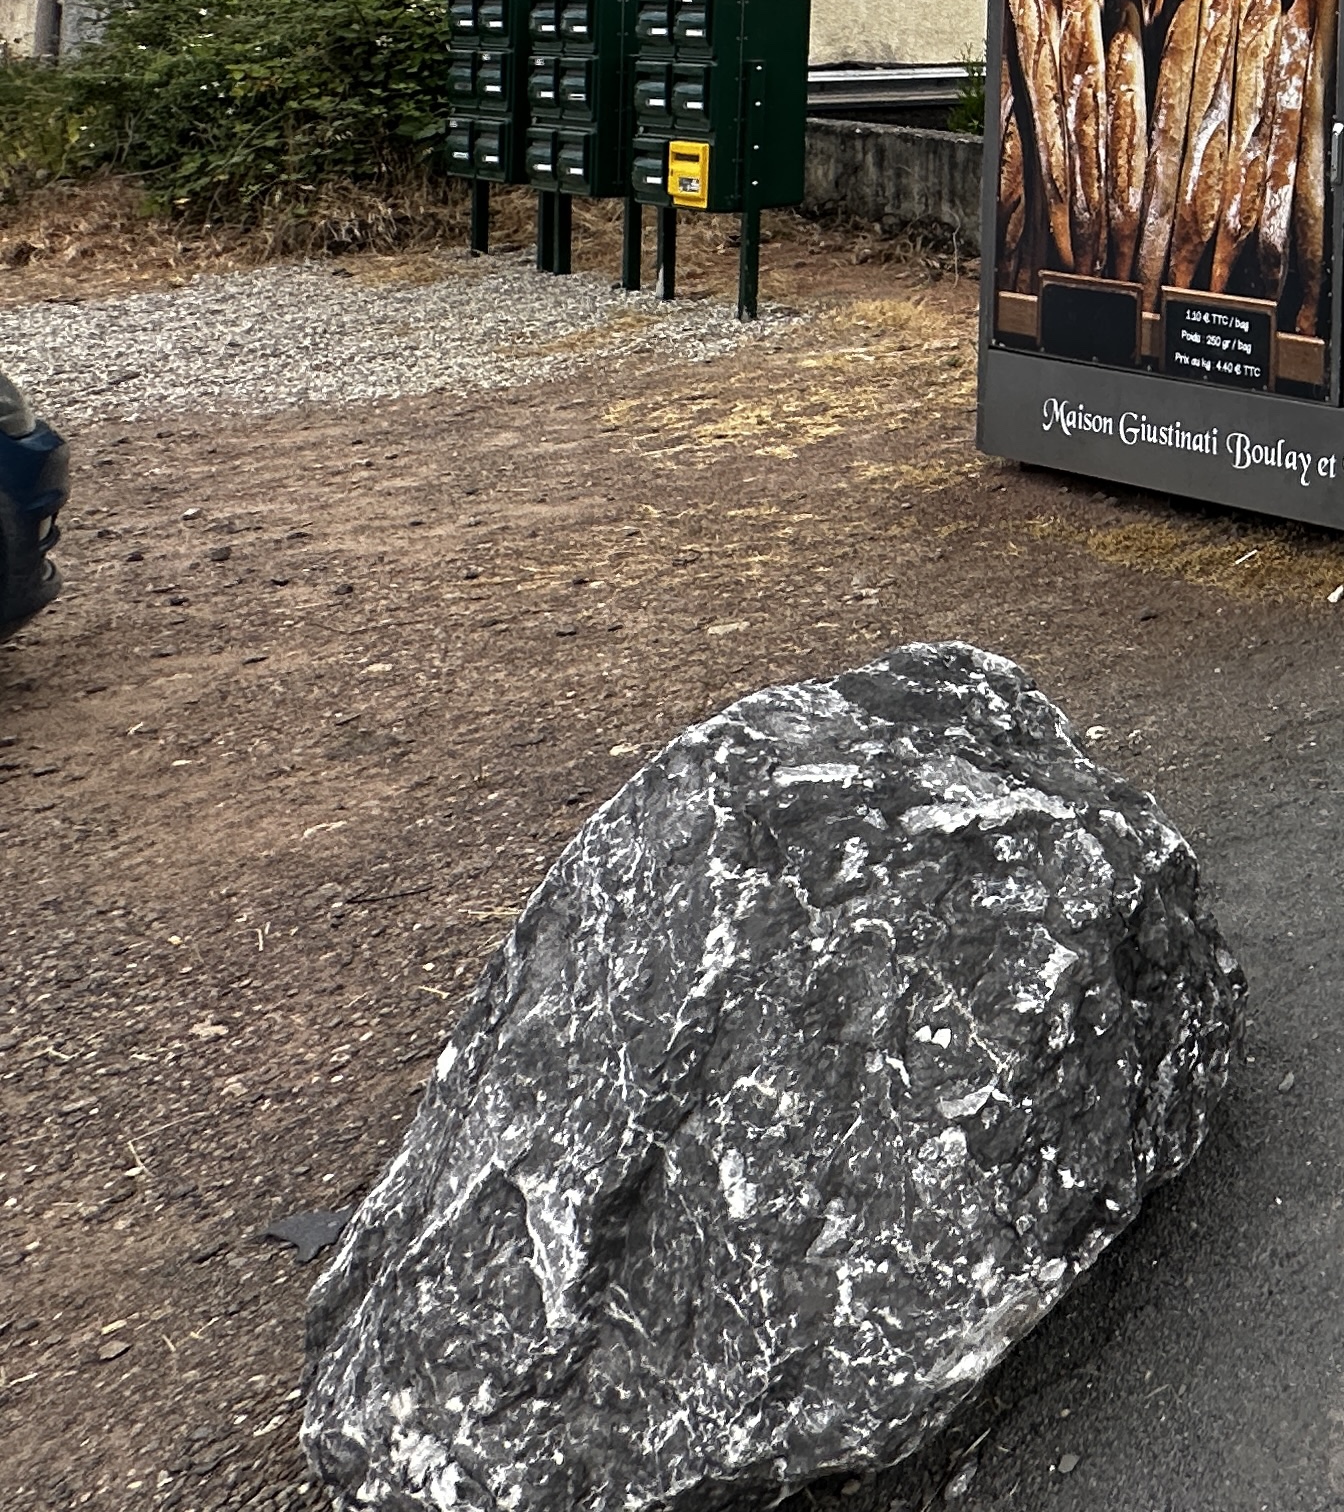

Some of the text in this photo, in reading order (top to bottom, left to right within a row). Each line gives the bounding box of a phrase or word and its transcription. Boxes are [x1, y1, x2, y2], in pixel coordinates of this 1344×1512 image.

[1211, 313, 1228, 326] TTC
[1243, 365, 1261, 377] TTC
[1042, 397, 1113, 436] Maison
[1119, 412, 1217, 456] Giustinati
[1226, 432, 1311, 486] Boulay
[1317, 457, 1337, 478] et
